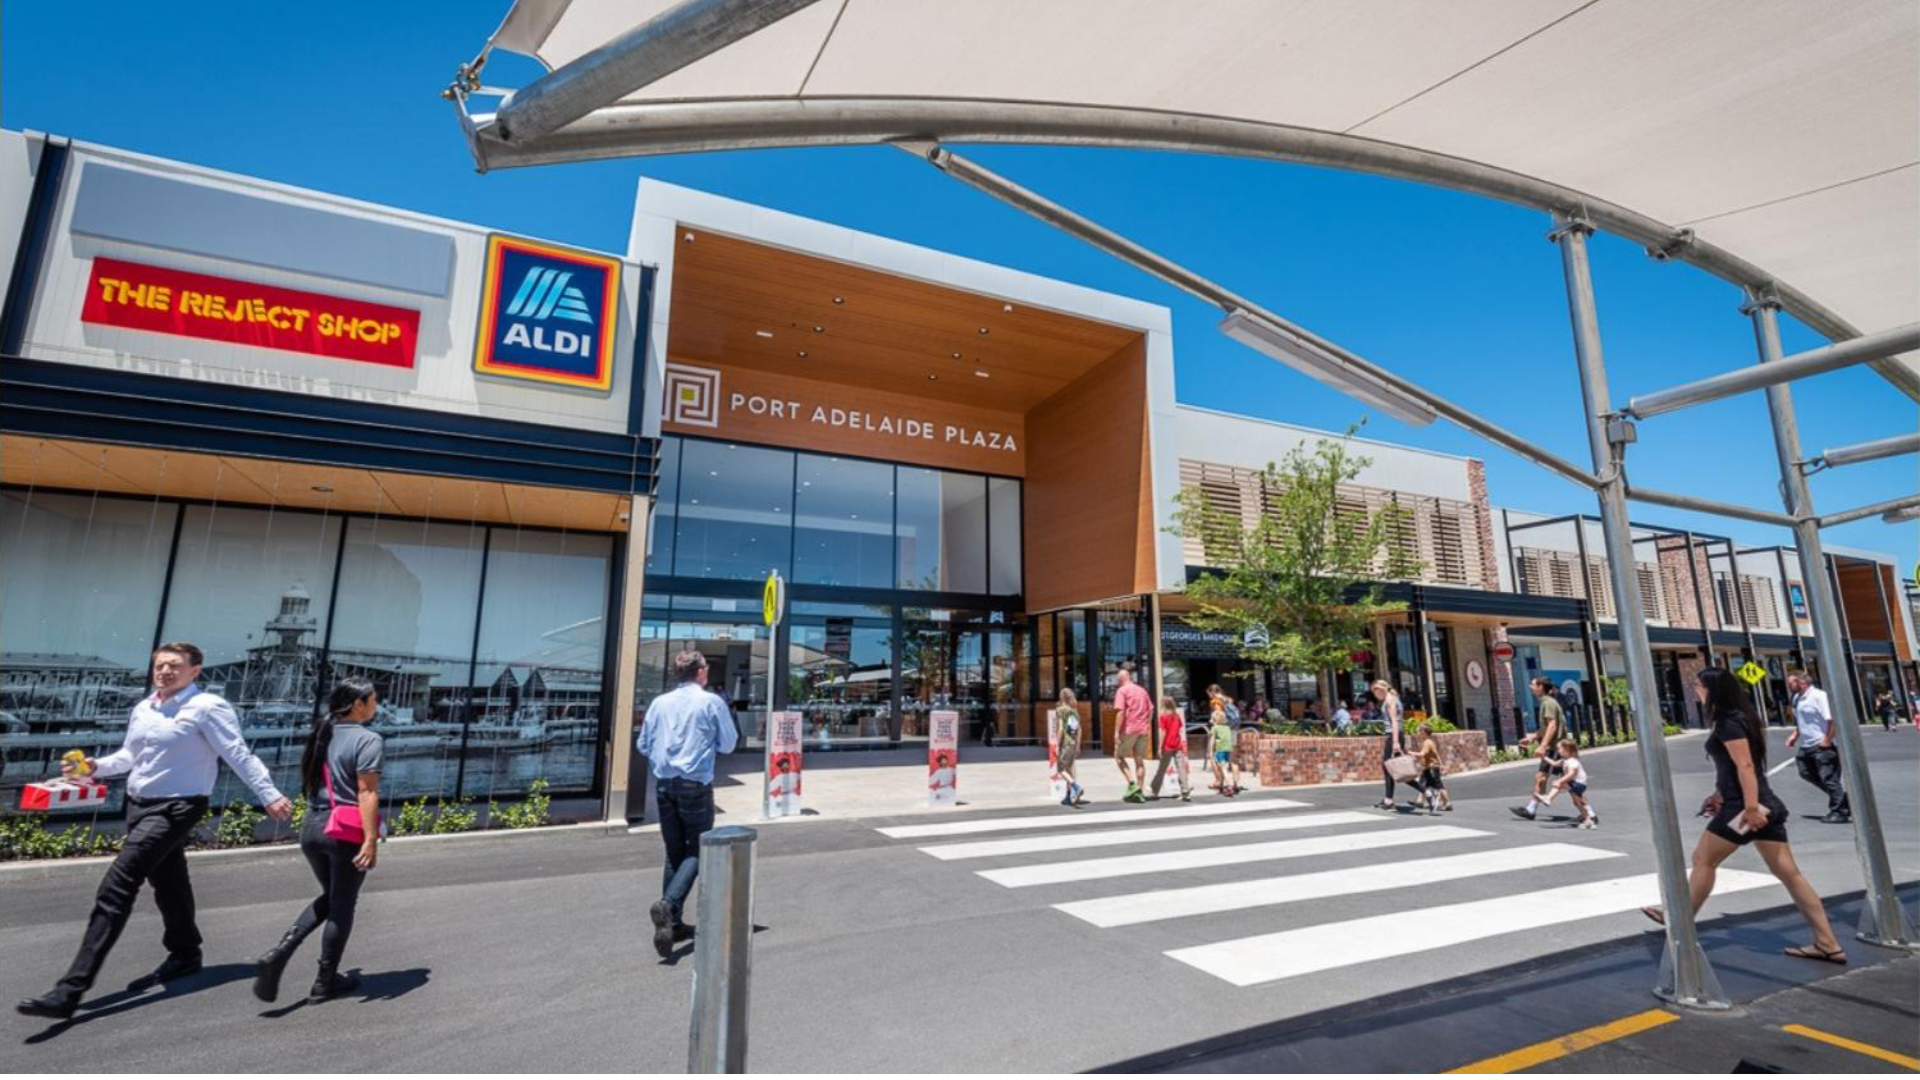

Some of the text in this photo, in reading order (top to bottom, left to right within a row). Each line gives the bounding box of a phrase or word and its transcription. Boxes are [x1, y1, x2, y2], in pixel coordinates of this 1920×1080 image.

[98, 277, 401, 345] THE REJECT SHOP
[502, 322, 592, 358] ALDI
[730, 392, 1018, 452] PORT ADELAIDE PLAZA
